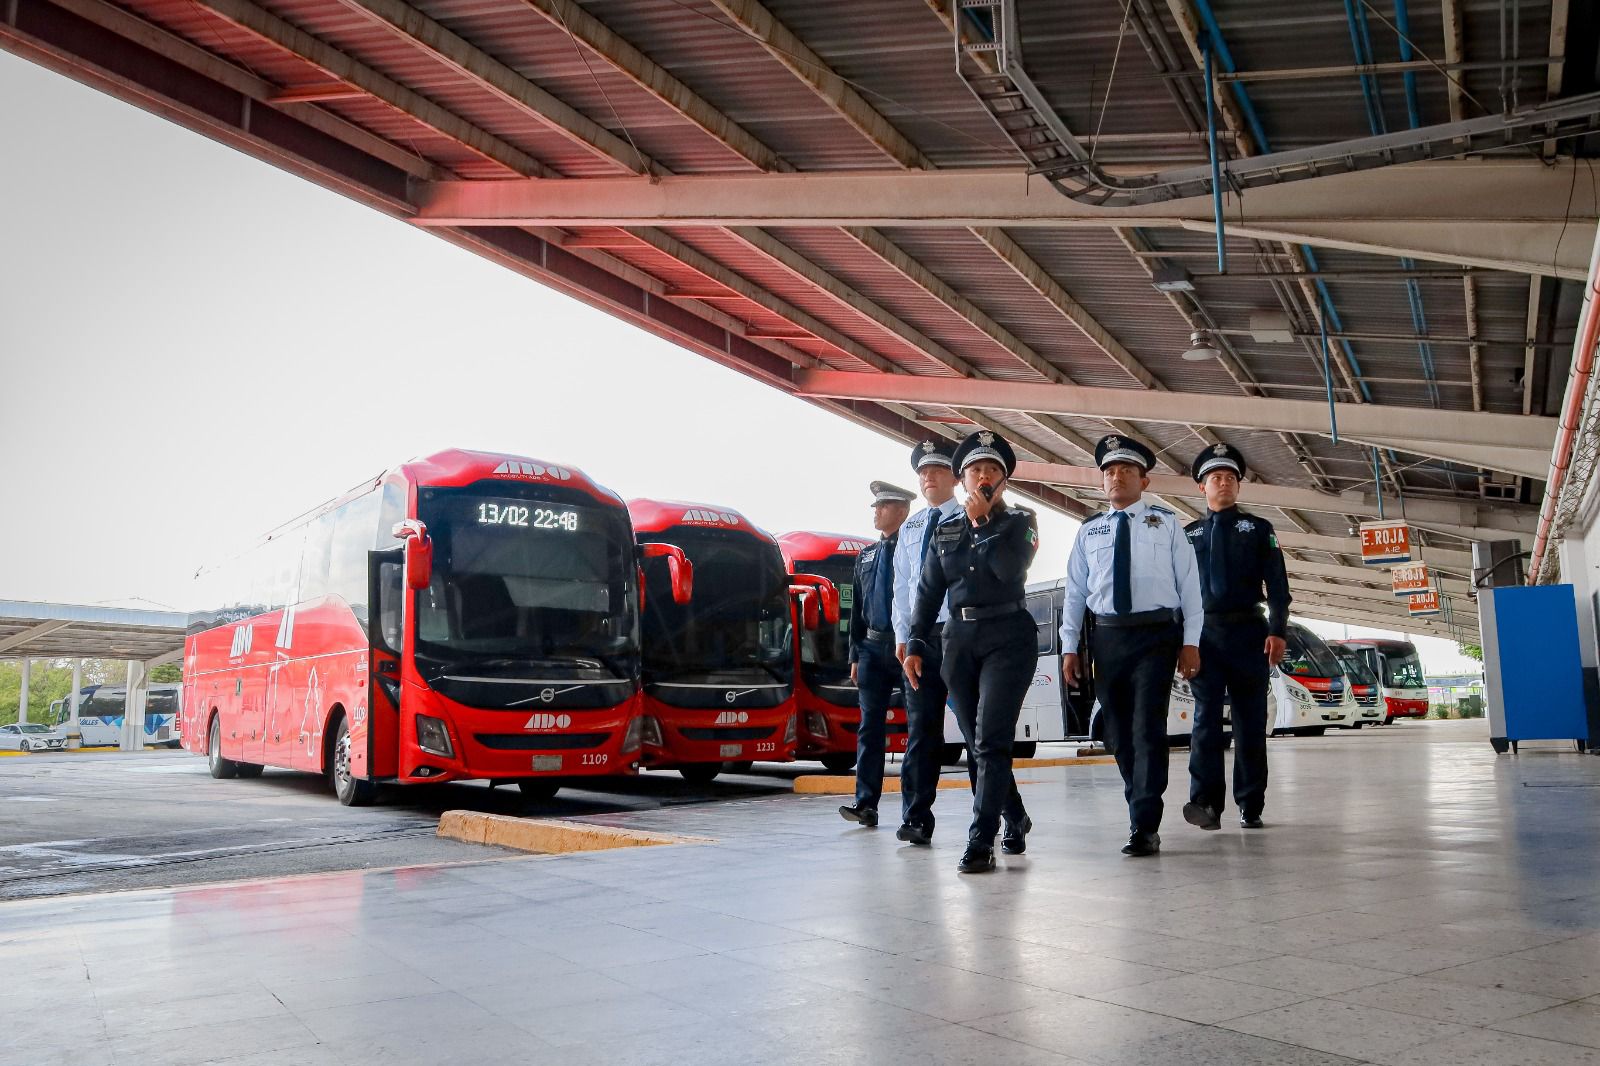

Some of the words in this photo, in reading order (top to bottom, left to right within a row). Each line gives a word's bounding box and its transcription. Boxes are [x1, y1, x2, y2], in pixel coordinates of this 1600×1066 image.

[492, 460, 571, 480] ADO
[478, 503, 528, 526] 13/02
[533, 508, 578, 531] 22:48
[681, 509, 739, 525] ADO
[1361, 528, 1405, 545] E.ROJA
[1410, 593, 1435, 604] E.ROJA
[230, 624, 253, 658] ADO
[523, 713, 572, 729] ADO
[714, 711, 749, 724] ADO
[756, 742, 776, 752] 1233
[581, 753, 608, 765] 1109
